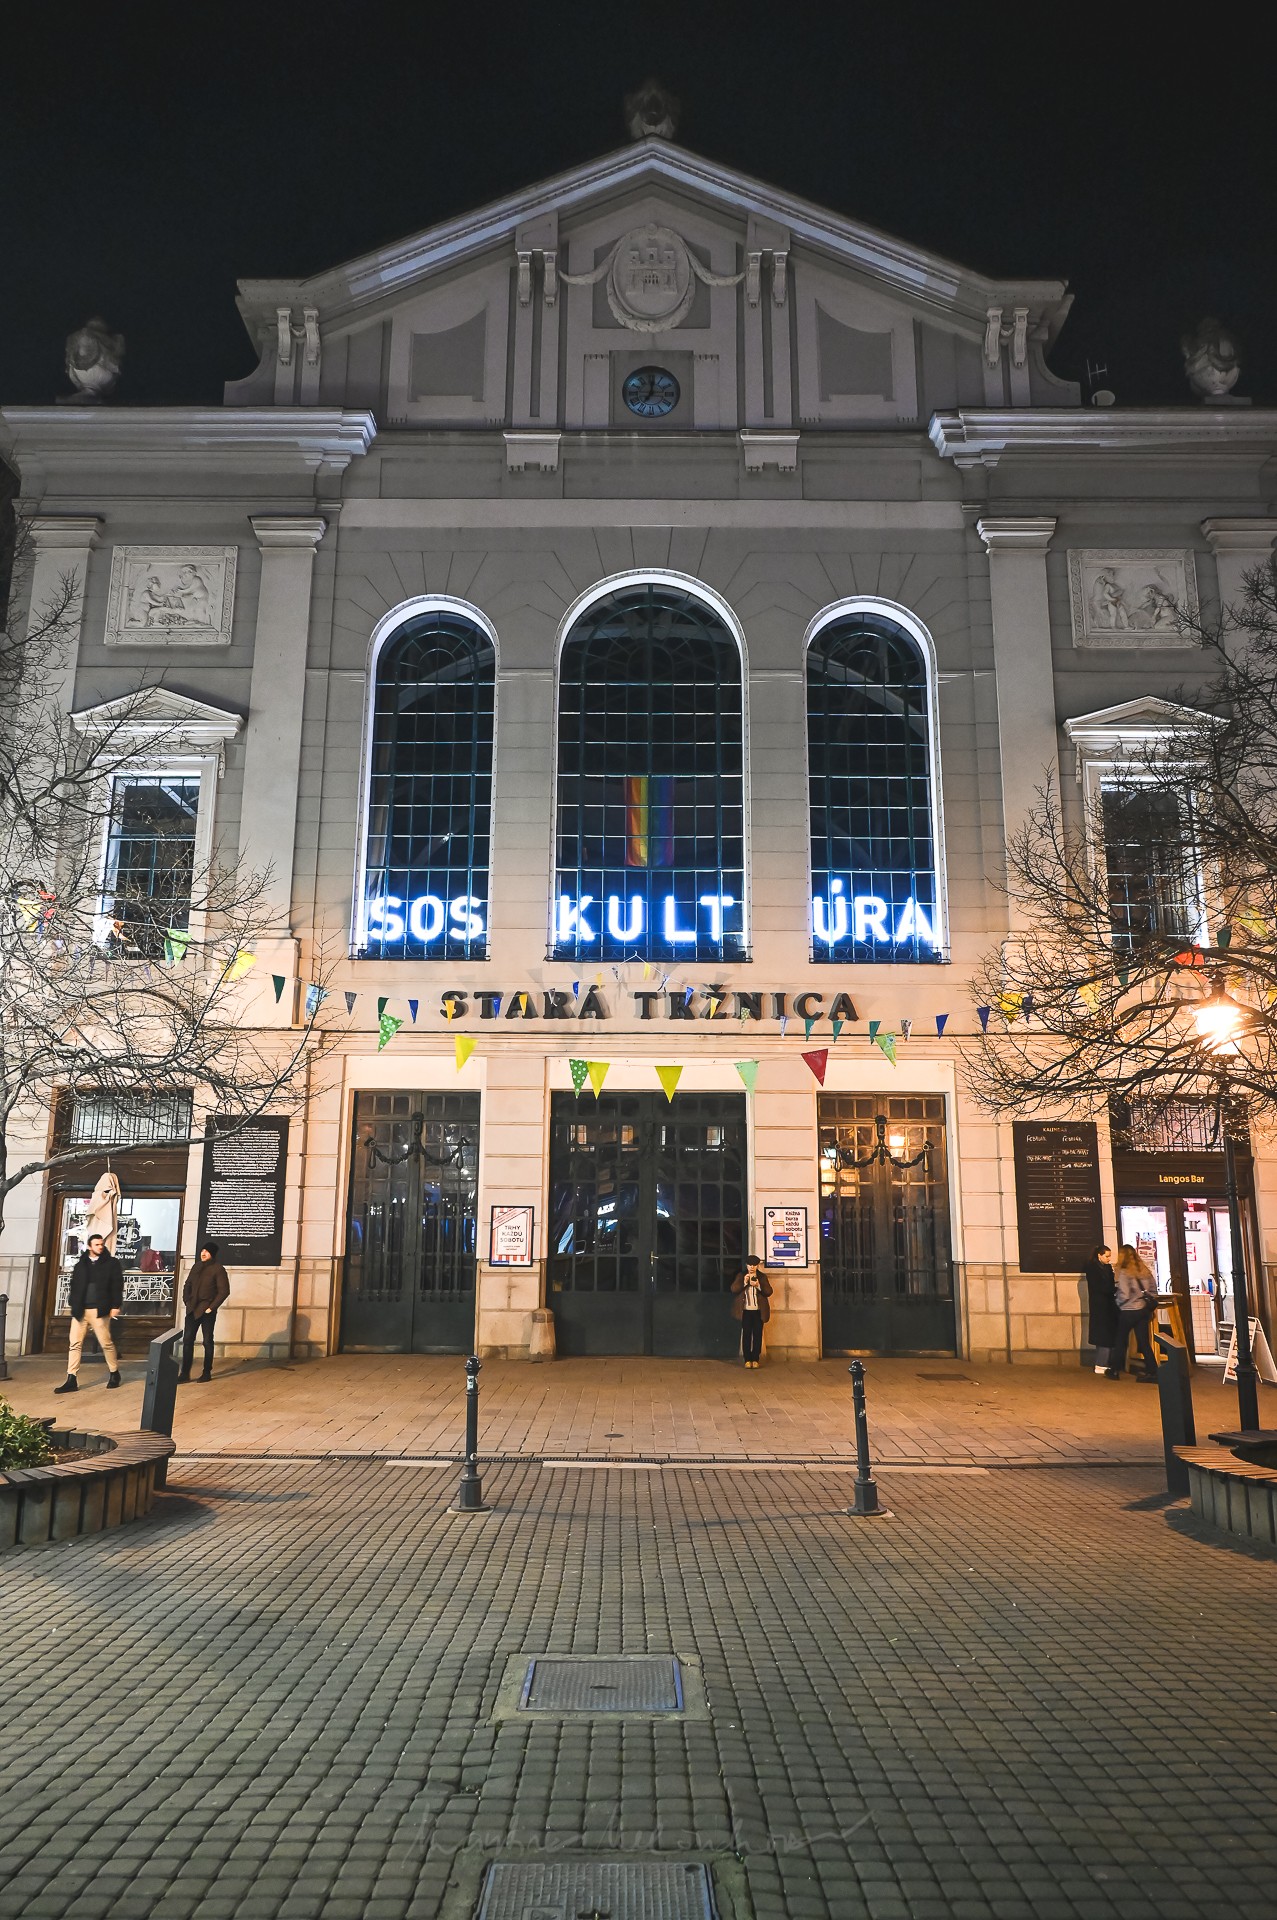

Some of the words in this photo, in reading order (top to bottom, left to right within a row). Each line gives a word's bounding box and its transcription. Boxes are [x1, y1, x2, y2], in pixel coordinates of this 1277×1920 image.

[369, 895, 485, 941] SOS
[559, 895, 734, 941] KULT
[814, 878, 935, 942] ÚRA
[440, 985, 607, 1020] STARÁ
[635, 984, 859, 1021] TRŽNICA
[1159, 1174, 1189, 1184] Langos
[1190, 1175, 1204, 1183] Bar
